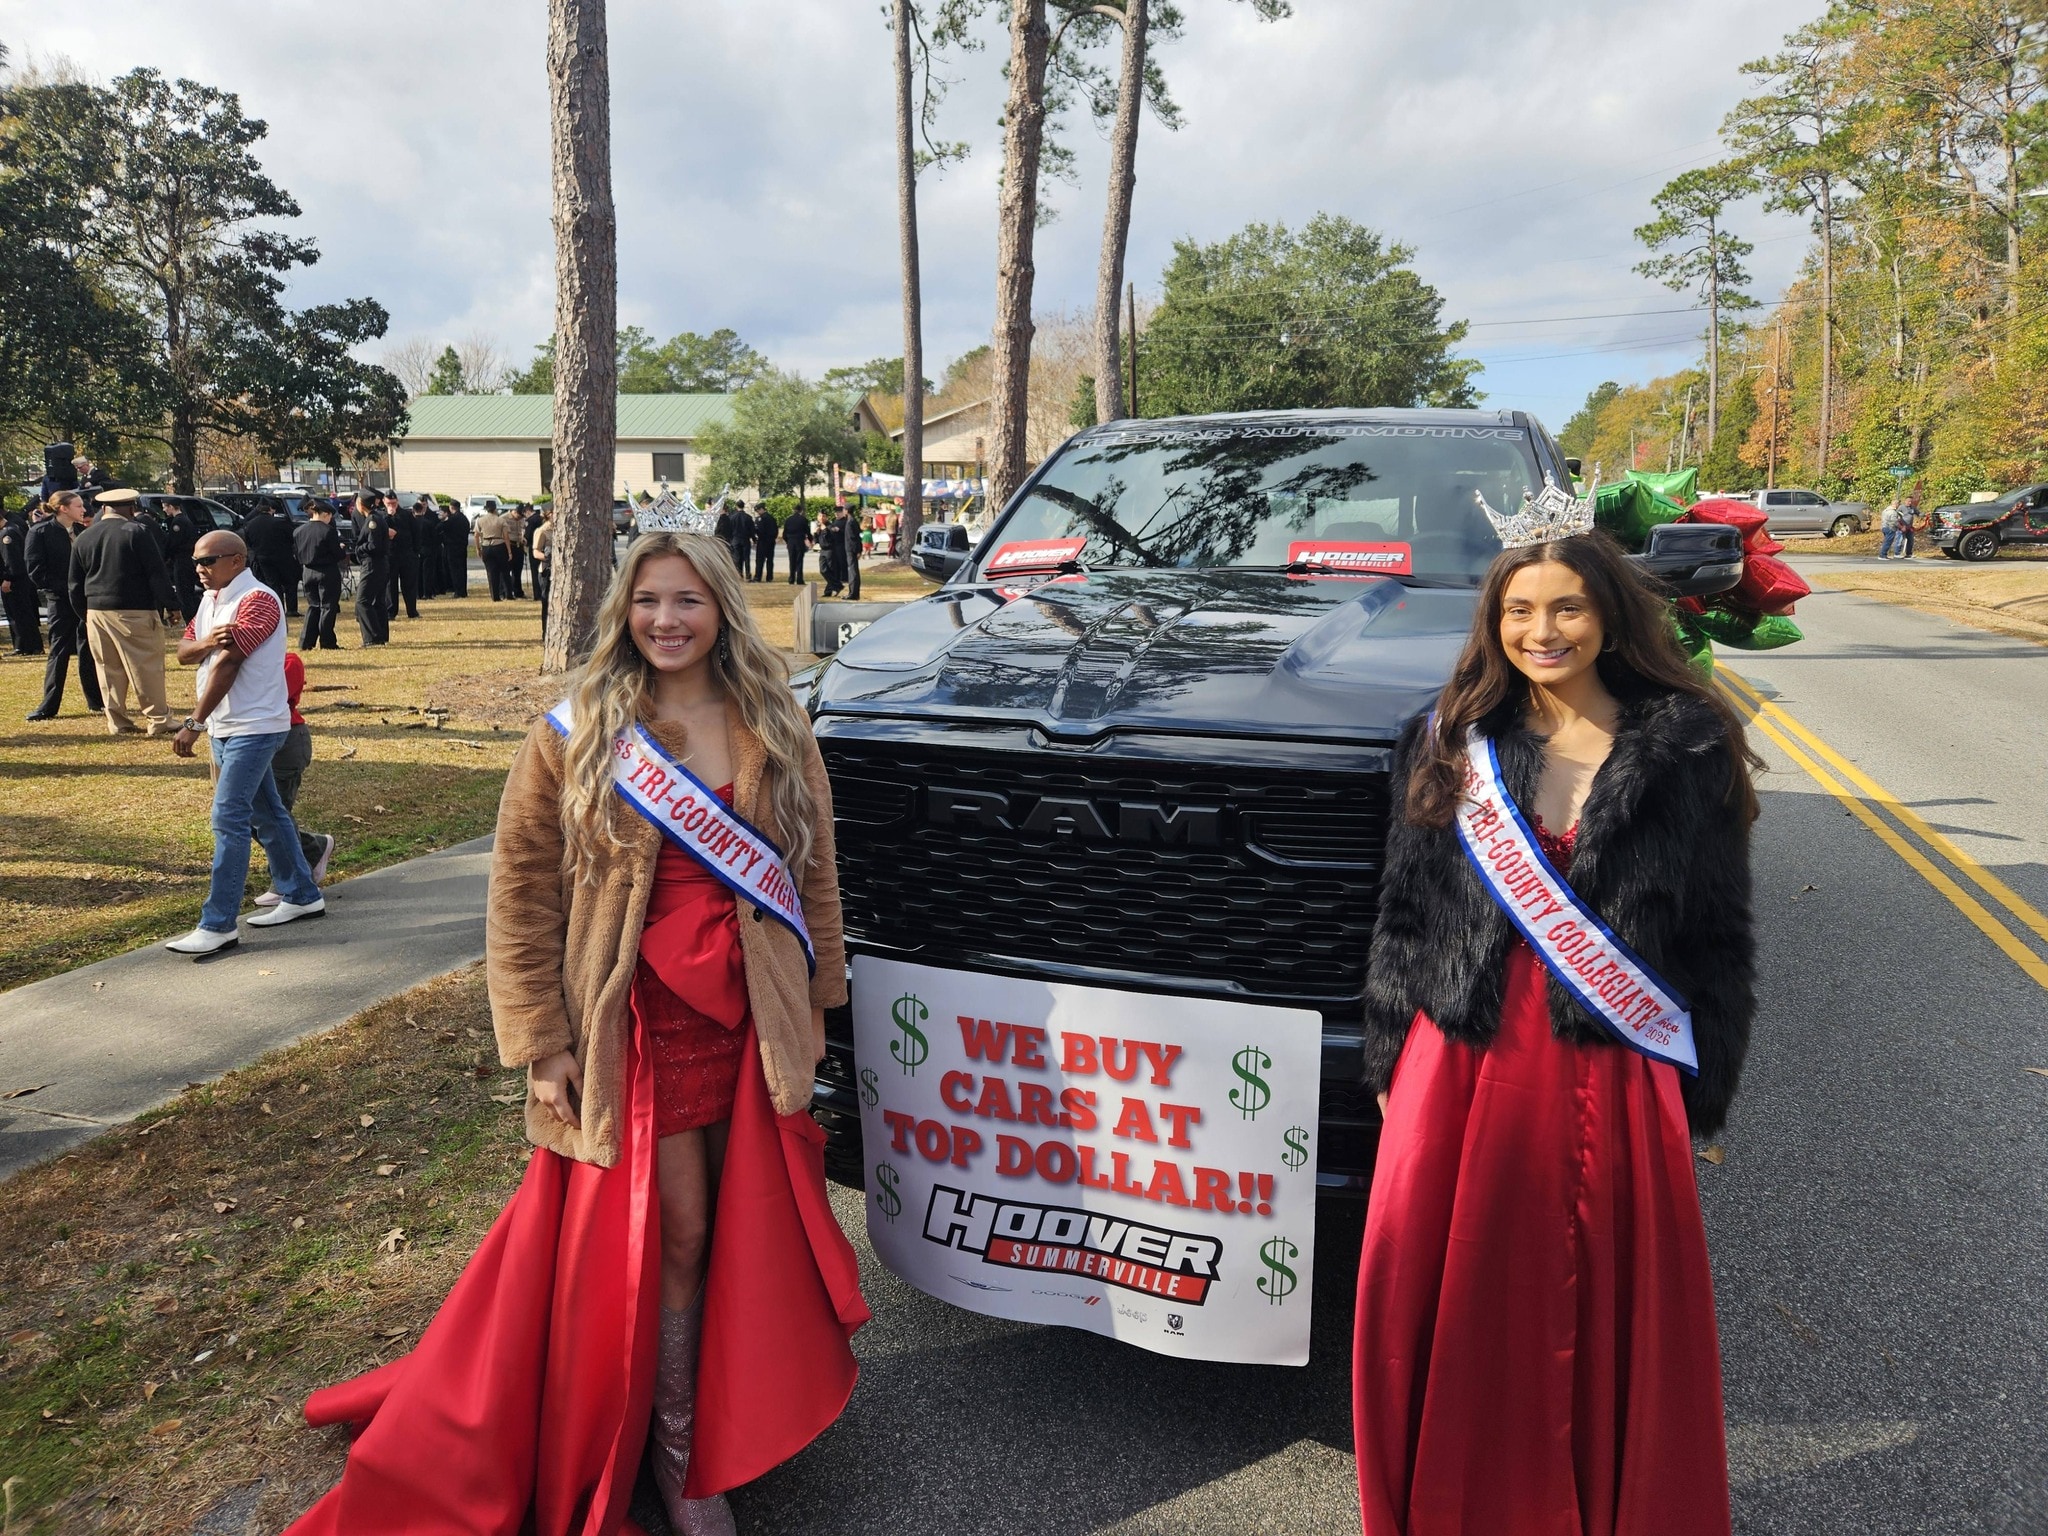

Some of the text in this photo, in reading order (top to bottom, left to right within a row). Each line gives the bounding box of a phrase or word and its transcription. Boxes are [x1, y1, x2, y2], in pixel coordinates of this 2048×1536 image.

[1244, 426, 1524, 441] AUTOMOTIVE
[1296, 551, 1406, 564] HOOVER
[627, 757, 764, 878] TRI-COUNTY
[756, 863, 795, 916] HIGH
[928, 785, 1220, 844] RAM
[1467, 799, 1563, 923] TRI-COUNTY
[1546, 920, 1662, 1033] COLLEGIATE
[957, 1015, 1182, 1087] WE BUY
[1645, 1026, 1671, 1046] 2026
[940, 1070, 1200, 1149] CARS AT
[883, 1109, 1274, 1217] TOP DOLLAR!!
[922, 1184, 1222, 1280] HOOVER
[1010, 1244, 1182, 1297] SUMMERVILLE
[1163, 1329, 1185, 1337] RAM
